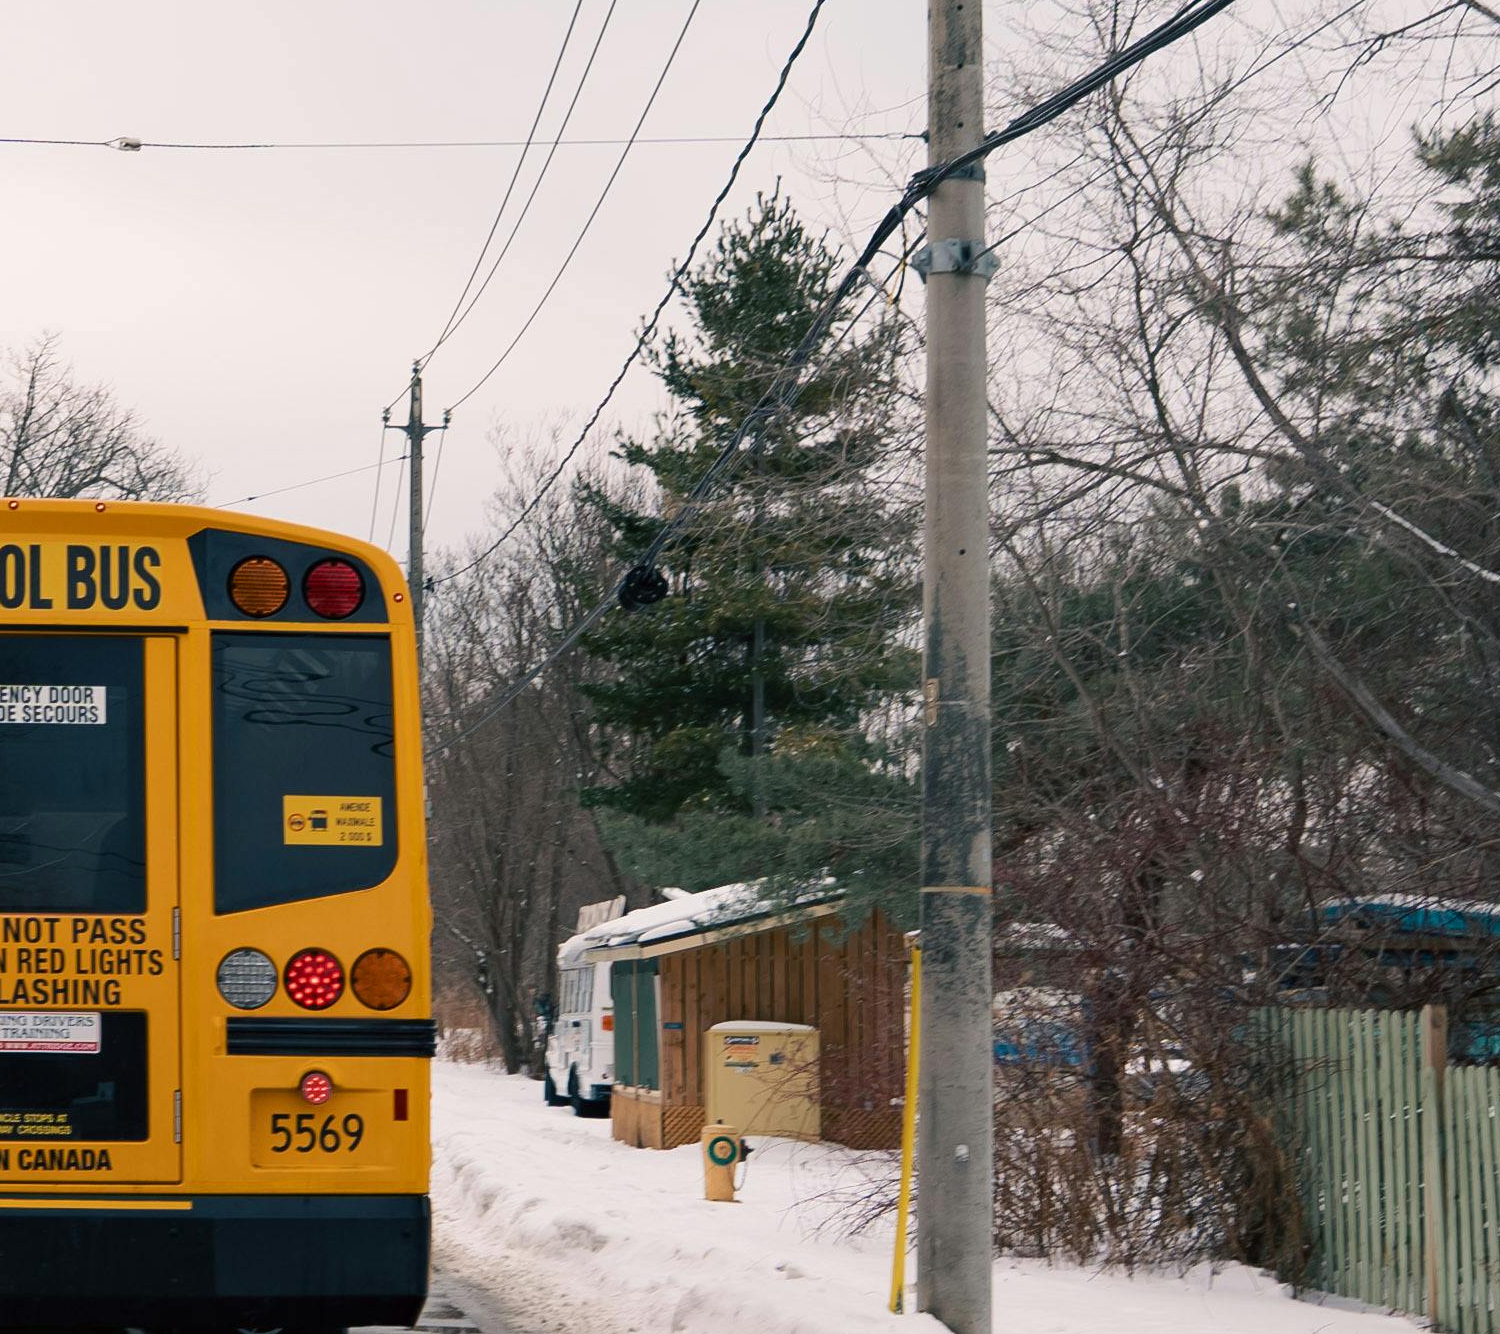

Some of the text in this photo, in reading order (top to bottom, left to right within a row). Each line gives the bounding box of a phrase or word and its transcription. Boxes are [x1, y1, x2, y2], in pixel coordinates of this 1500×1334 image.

[66, 544, 161, 611] BUS
[50, 686, 94, 704] DOOR
[22, 705, 99, 723] SECOURS
[3, 917, 60, 943] NOT
[71, 918, 146, 944] PASS
[17, 948, 65, 974] RED
[75, 949, 163, 975] LIGHTS
[32, 1016, 95, 1027] DRIVERS
[1, 1027, 71, 1039] TRAINING
[23, 1113, 54, 1123] STOPS
[17, 1125, 72, 1135] CROSSINGS
[271, 1113, 364, 1153] 5569
[17, 1148, 112, 1170] CANADA
